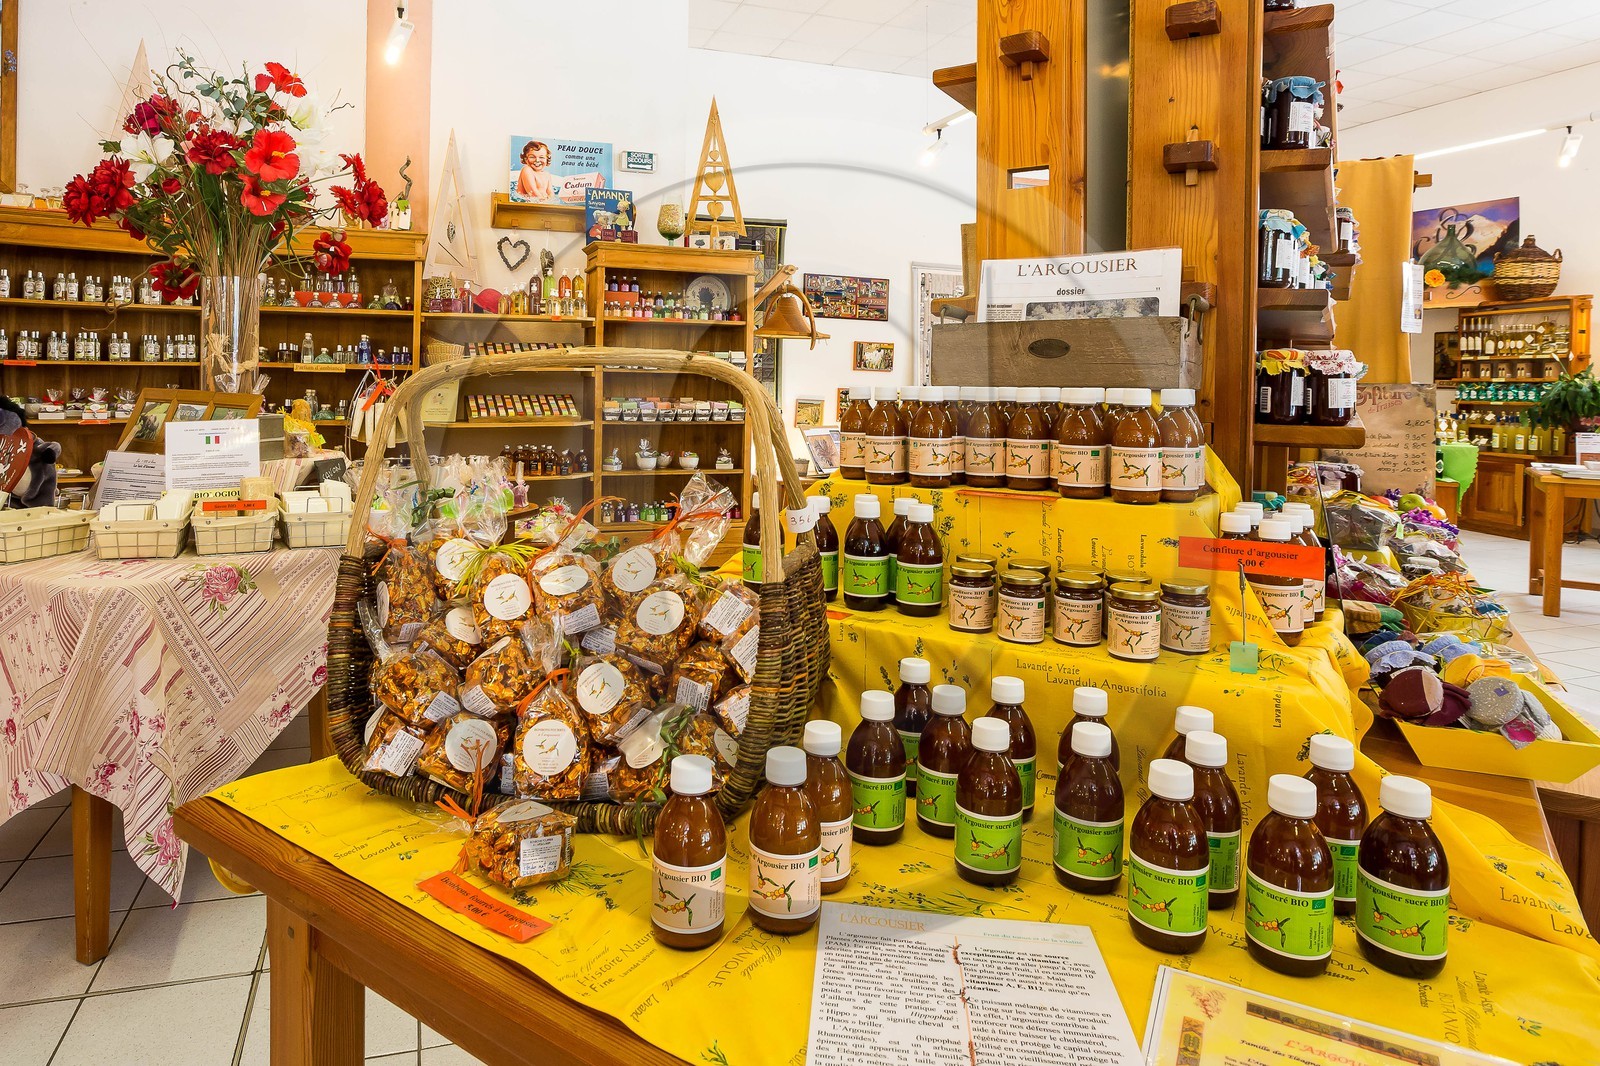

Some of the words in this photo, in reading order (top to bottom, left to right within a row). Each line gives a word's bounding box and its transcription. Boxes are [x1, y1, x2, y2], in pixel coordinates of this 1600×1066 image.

[564, 181, 592, 189] Cadum
[588, 189, 630, 201] L'AMANDE
[1017, 258, 1138, 277] L'ARGOUSIER
[1056, 287, 1085, 296] dossier
[1376, 400, 1402, 412] fraises
[1203, 544, 1244, 556] Confiture
[1247, 548, 1298, 560] d'argousier
[1237, 558, 1257, 567] 5,00
[1113, 611, 1140, 619] Confiture
[1164, 606, 1190, 614] Confiture
[1017, 659, 1052, 672] Lavande
[1056, 664, 1080, 675] Vraie
[1046, 673, 1098, 689] Lavandula
[1101, 679, 1167, 698] Angustifolia
[1273, 690, 1282, 728] Lavande
[1237, 753, 1250, 795] Lavande
[1242, 800, 1252, 826] Vraie
[1064, 823, 1102, 836] d'Argousier
[1103, 825, 1118, 836] sucré
[333, 842, 369, 861] Stoechas
[360, 840, 401, 861] Lavande
[752, 853, 789, 870] d'Argousier
[790, 862, 805, 870] BIO
[691, 874, 707, 882] BIO
[1154, 874, 1176, 885] sucré
[1178, 876, 1193, 886] BIO
[440, 876, 469, 896] Bonbons
[469, 895, 494, 910] fourrés
[1266, 891, 1288, 904] sucré
[1291, 897, 1309, 908] BIO
[1404, 895, 1429, 907] sucré
[1430, 898, 1444, 907] BIO
[840, 913, 925, 931] L'ARGOUSIER
[1208, 925, 1246, 941] Vraie
[853, 938, 895, 947] Aromatiques
[907, 944, 949, 953] Médicinales
[577, 956, 622, 986] Histoire
[620, 930, 655, 958] Nature
[708, 932, 773, 988] OTANIQUE
[880, 952, 911, 961] première
[961, 951, 1013, 960] exceptionnelle
[589, 977, 615, 992] Fine
[981, 999, 1013, 1007] puissant
[1014, 1002, 1048, 1012] mélange
[1061, 1008, 1100, 1017] vitamines
[1439, 992, 1461, 1043] BOTANIQ
[832, 1025, 881, 1036] L'Argousier
[971, 1018, 1008, 1028] renforcer
[1026, 1024, 1061, 1034] défenses
[1062, 1028, 1120, 1041] immunitaires,
